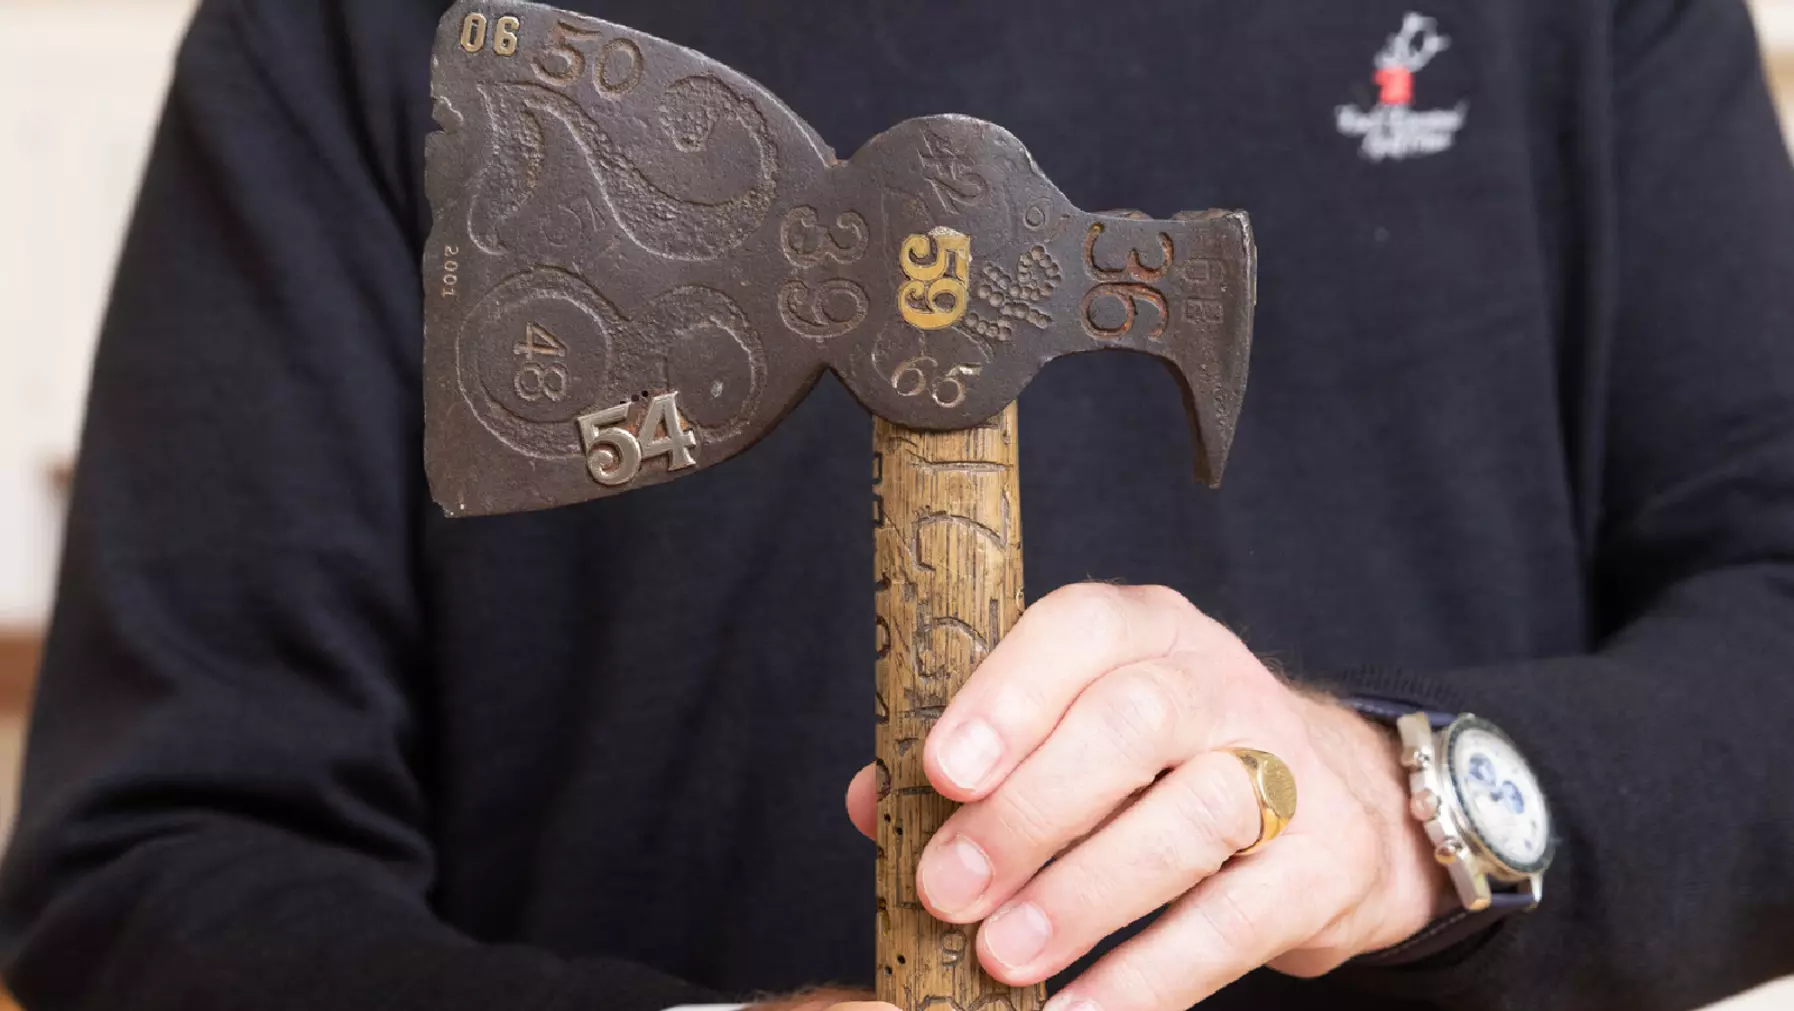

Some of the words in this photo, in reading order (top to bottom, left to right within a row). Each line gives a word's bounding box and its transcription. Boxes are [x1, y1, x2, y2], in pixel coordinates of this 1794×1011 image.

[460, 12, 520, 57] 06
[530, 18, 644, 98] 50
[441, 244, 460, 299] 2001
[778, 205, 869, 340] 39
[898, 226, 971, 330] 59
[1081, 222, 1174, 343] 36
[512, 320, 568, 402] 48
[576, 389, 697, 487] 54
